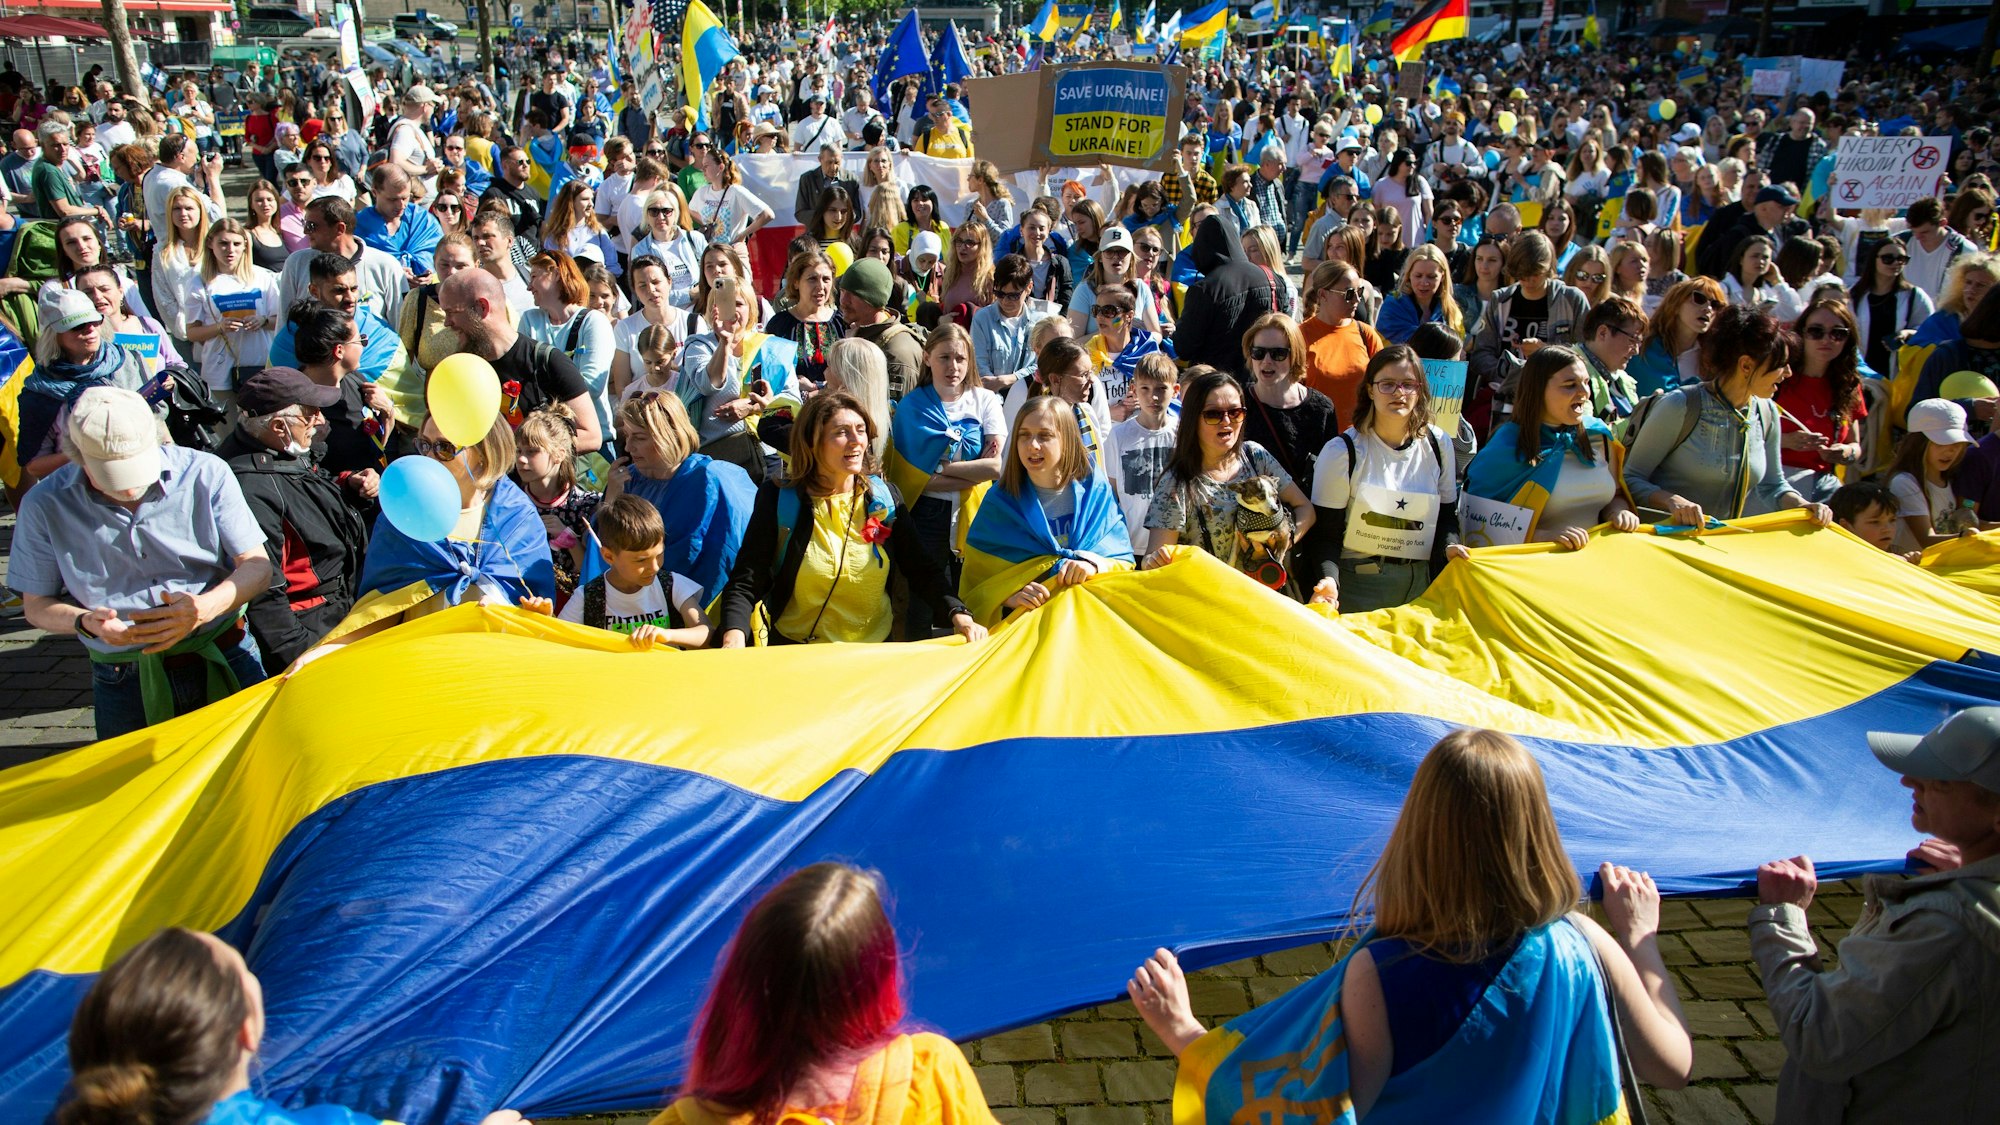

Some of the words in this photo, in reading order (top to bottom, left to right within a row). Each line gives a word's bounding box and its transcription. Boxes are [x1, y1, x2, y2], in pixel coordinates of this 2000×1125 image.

[1060, 86, 1092, 101] SAVE
[1095, 84, 1164, 102] UKRAINE!
[1065, 116, 1113, 132] STAND
[1119, 117, 1151, 133] FOR
[1069, 137, 1143, 154] UKRAINE!
[1841, 138, 1907, 155] NEVER
[1835, 155, 1898, 172] НІКОЛИ
[1866, 175, 1928, 191] AGAIN
[1112, 231, 1121, 239] B
[1425, 363, 1448, 379] AVE
[1355, 529, 1380, 540] Russian
[1382, 536, 1405, 545] warship,
[1377, 543, 1402, 551] yourself.
